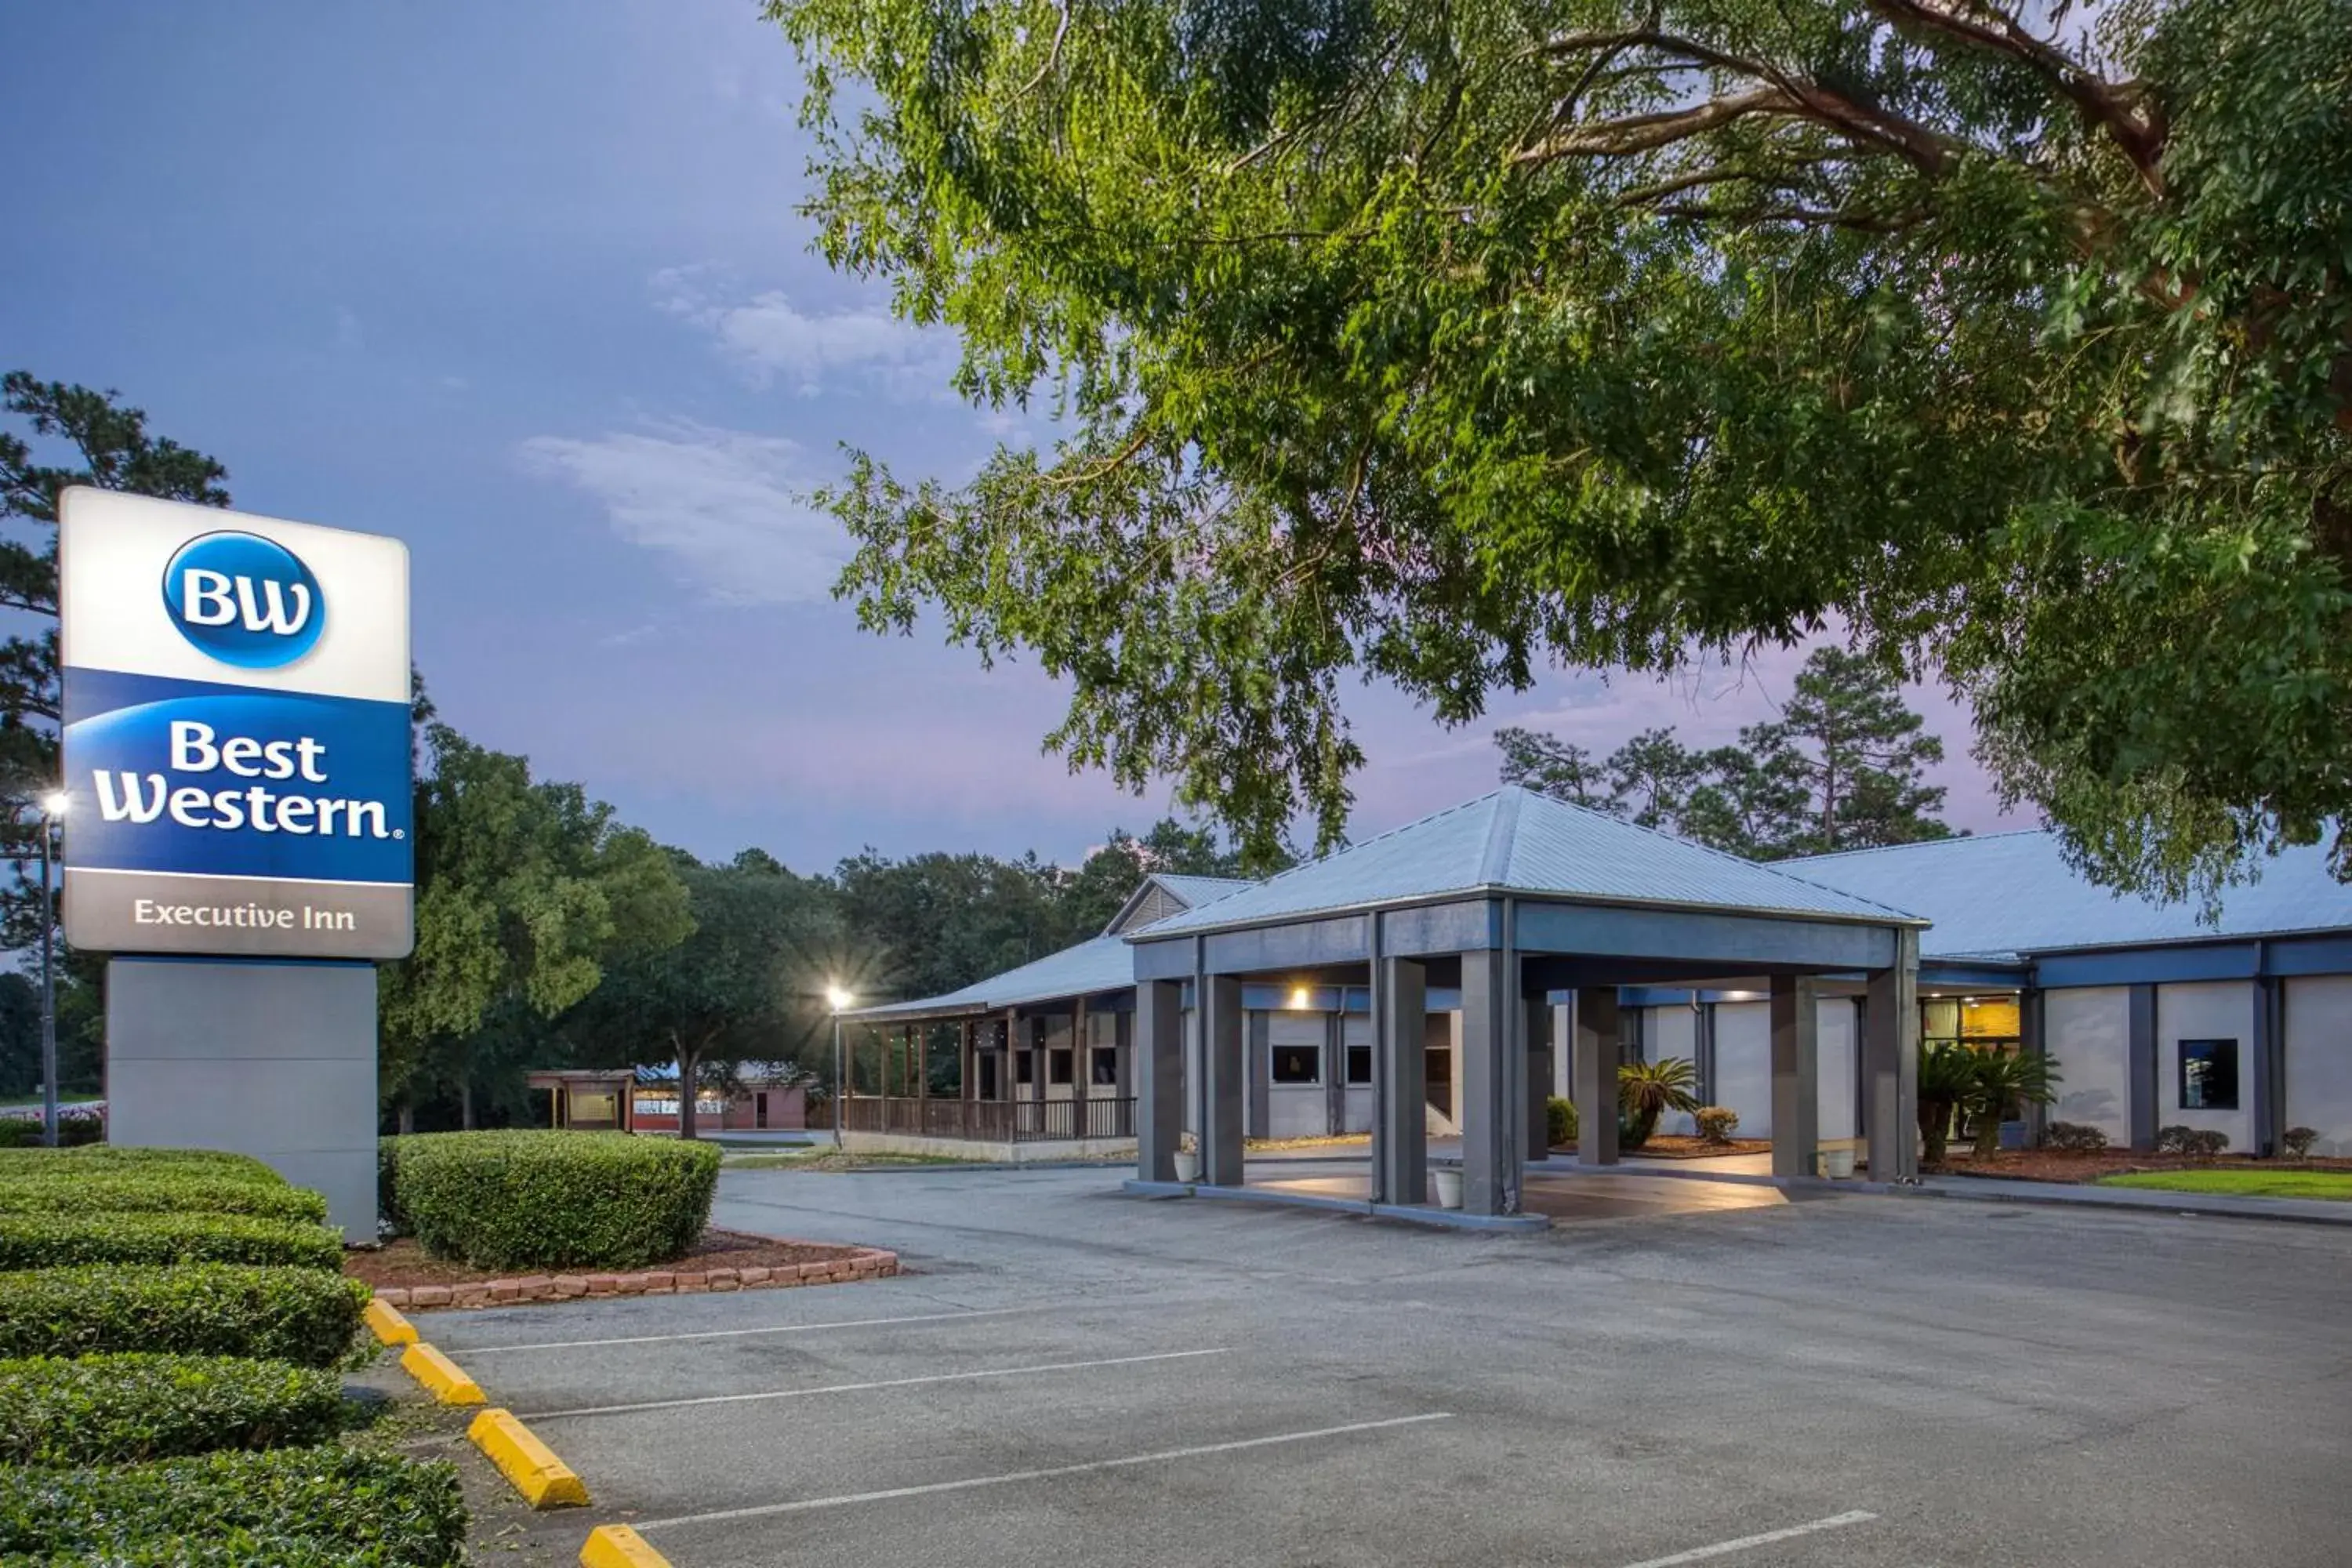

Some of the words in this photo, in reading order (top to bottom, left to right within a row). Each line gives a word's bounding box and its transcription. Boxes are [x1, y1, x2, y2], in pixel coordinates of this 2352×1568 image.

[183, 568, 310, 636] BW
[170, 720, 327, 782] Best
[93, 769, 389, 839] Western
[135, 898, 295, 929] Executive
[303, 905, 356, 931] Inn
